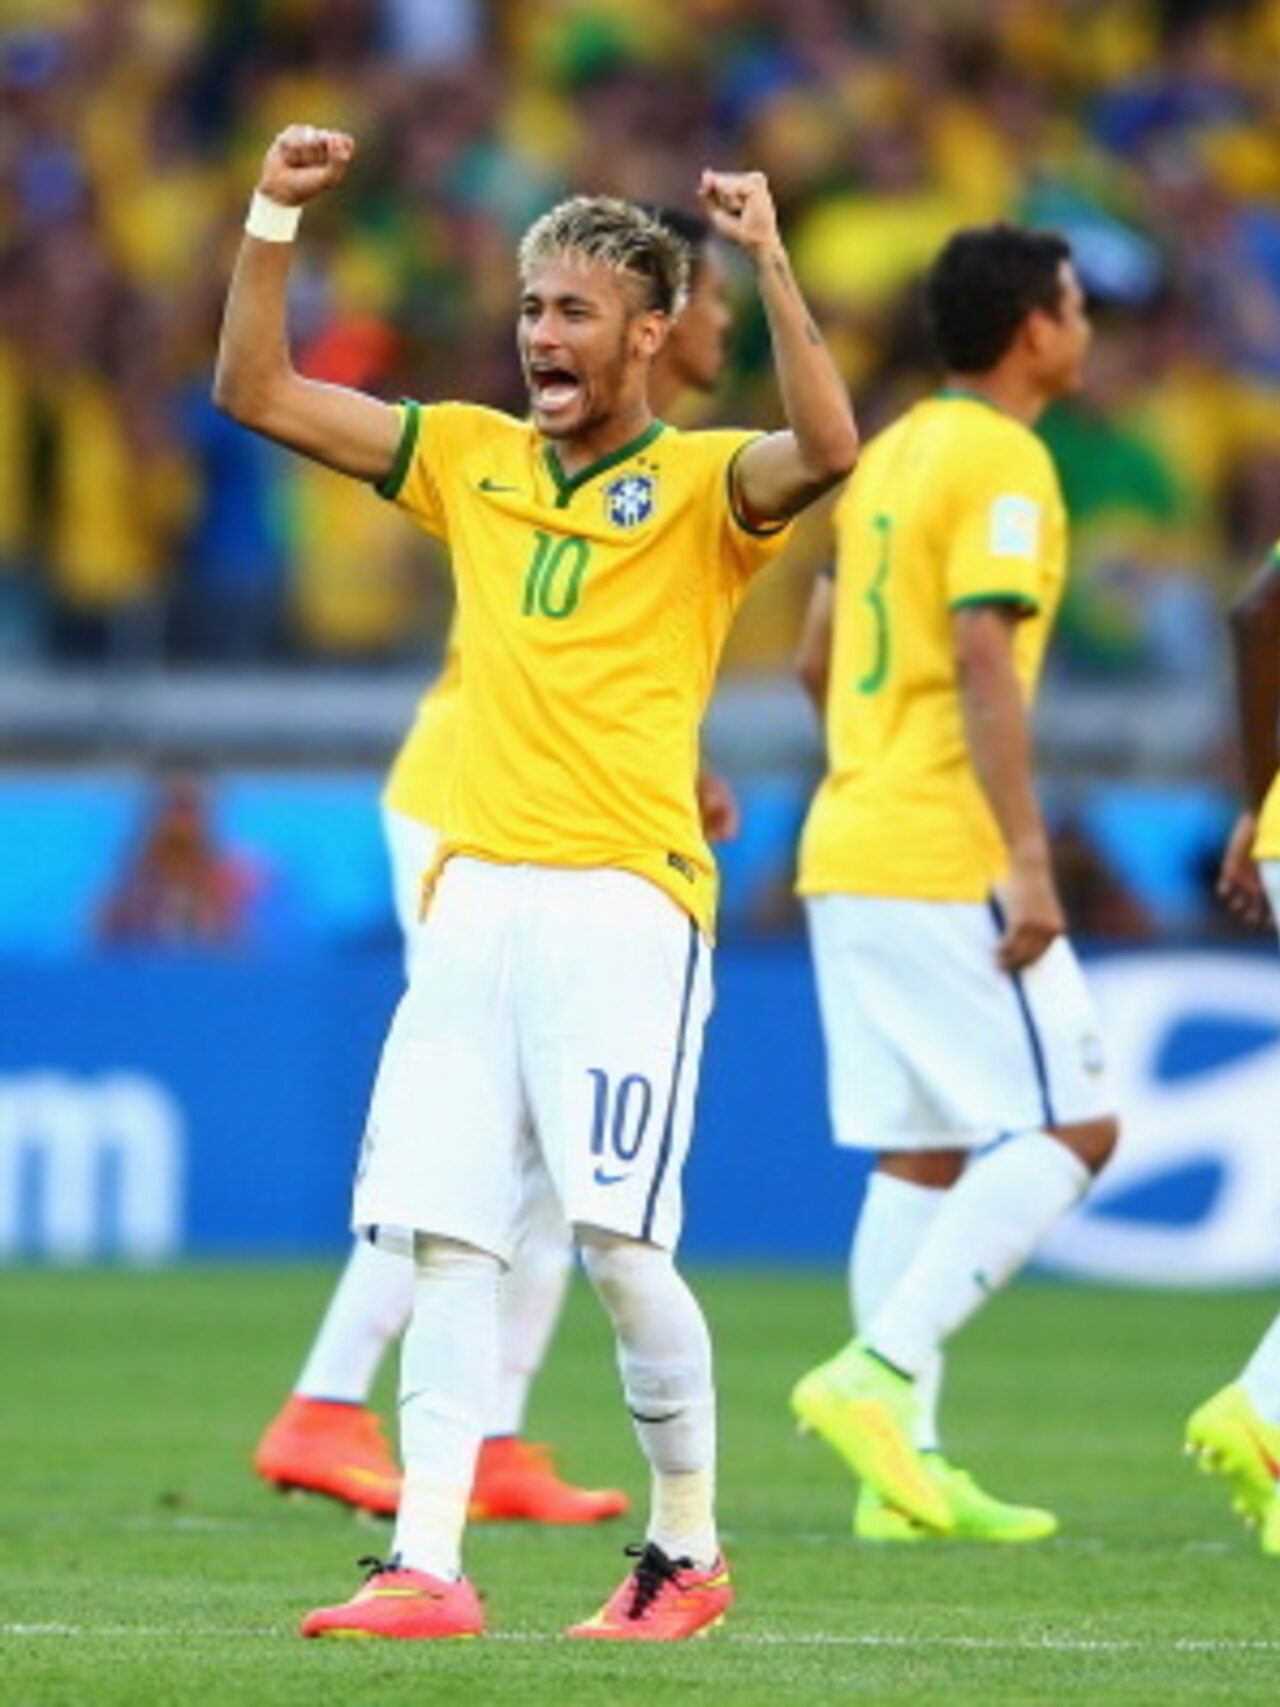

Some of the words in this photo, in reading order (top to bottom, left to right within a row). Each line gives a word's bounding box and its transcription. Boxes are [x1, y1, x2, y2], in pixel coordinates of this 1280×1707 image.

[522, 531, 591, 618] 10
[855, 515, 892, 694] 3
[586, 1067, 652, 1161] 10
